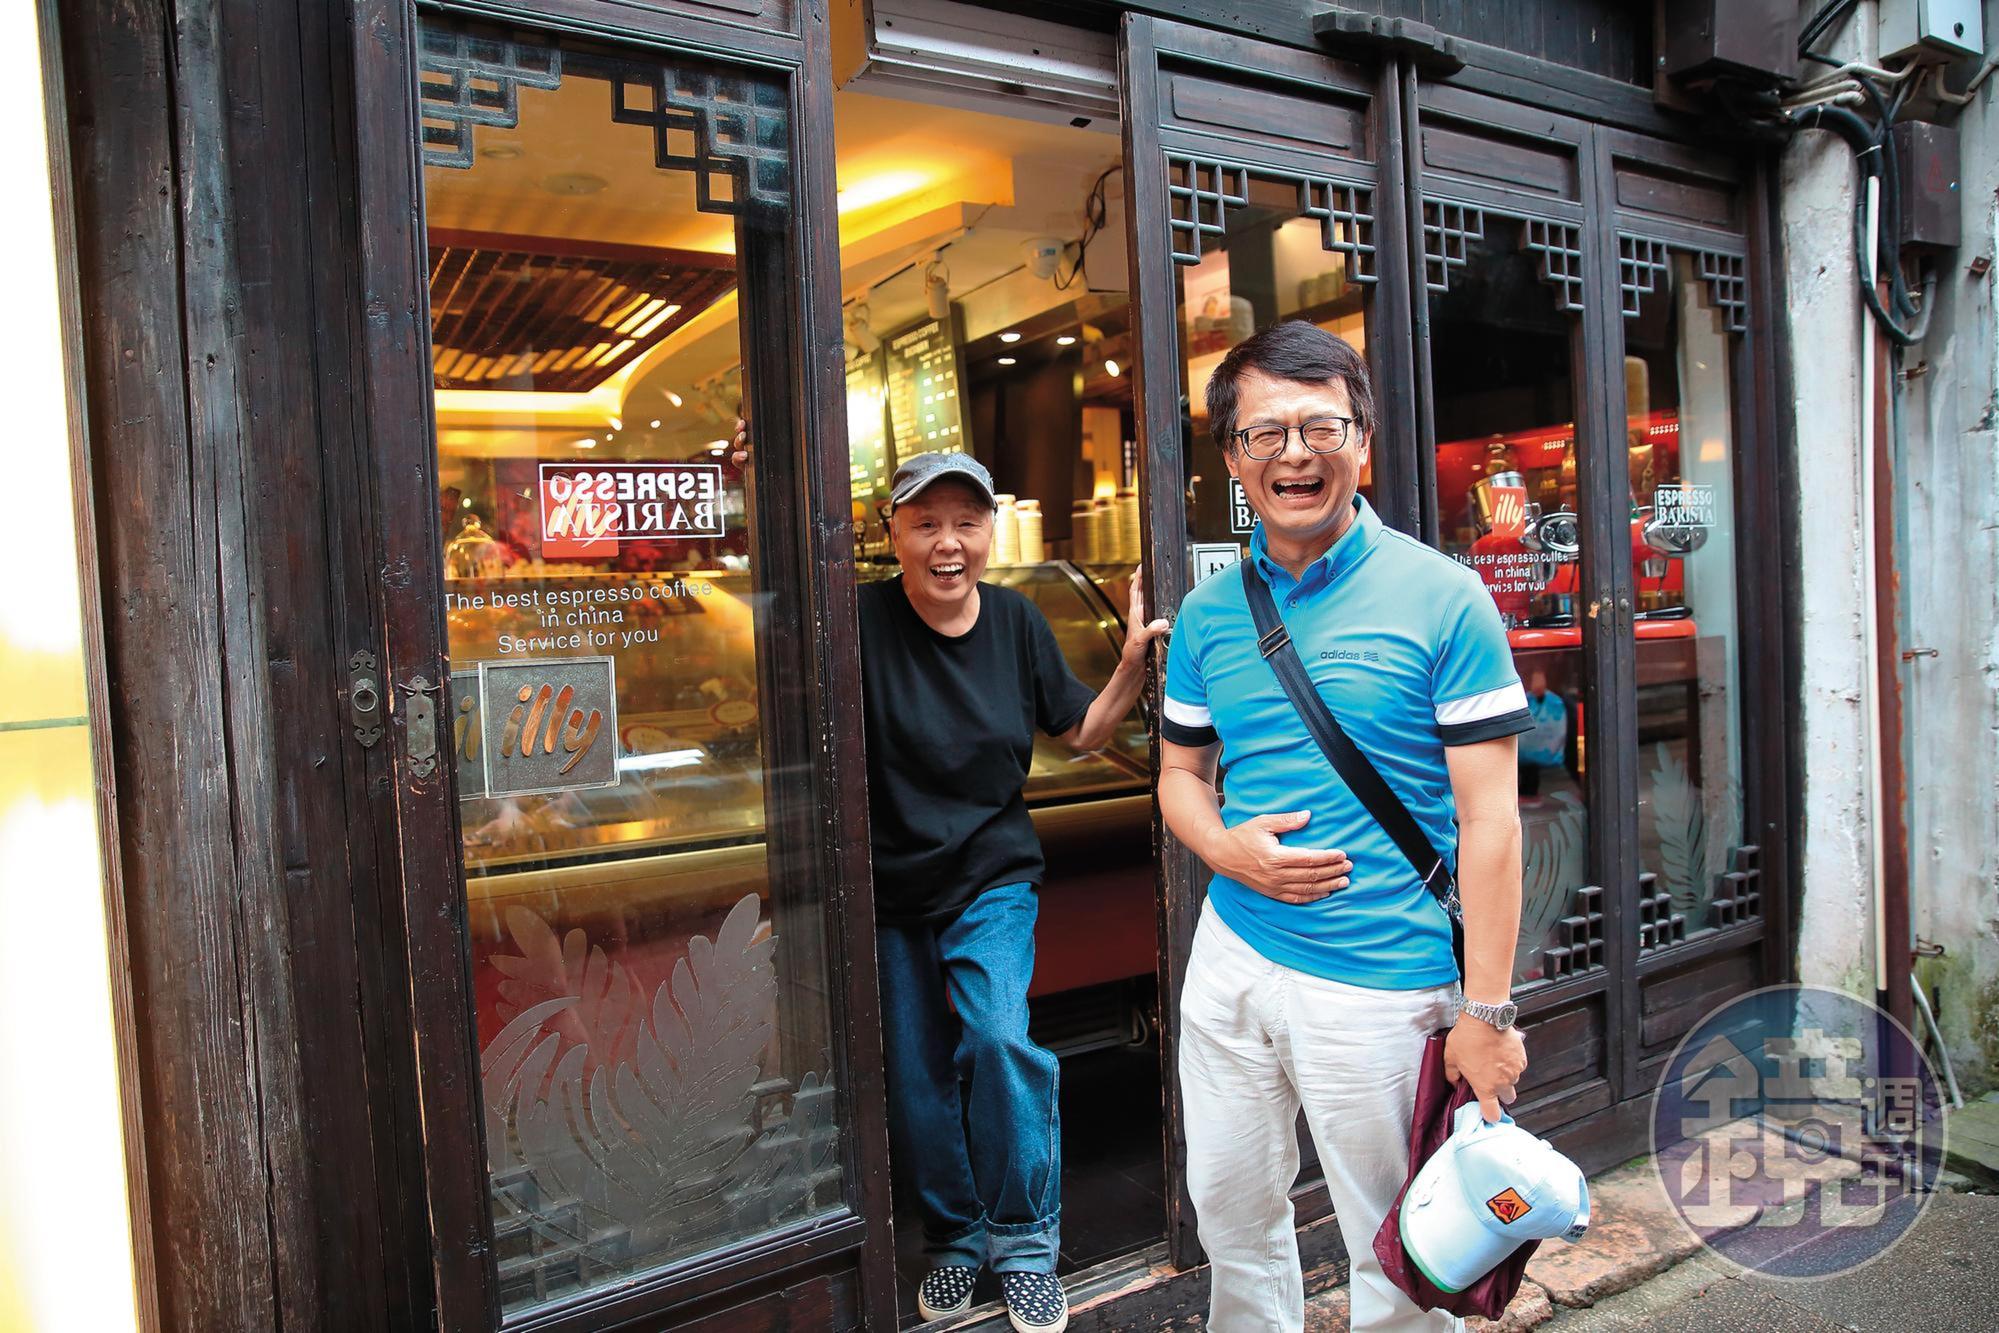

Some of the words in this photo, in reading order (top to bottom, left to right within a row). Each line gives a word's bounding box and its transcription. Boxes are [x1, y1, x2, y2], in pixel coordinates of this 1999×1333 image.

[1657, 489, 1712, 506] ESPRESSO
[1494, 494, 1523, 531] illy
[1658, 506, 1714, 524] BARISTA
[1494, 567, 1504, 579] in
[1505, 566, 1532, 579] china
[444, 593, 485, 612] The
[491, 589, 540, 609] best
[545, 584, 644, 609] espresso
[649, 580, 713, 601] coffee
[1485, 581, 1513, 593] ervice
[1514, 581, 1527, 592] for
[540, 609, 560, 628] in
[566, 605, 624, 627] china
[497, 632, 581, 654] Service
[586, 629, 616, 647] for
[621, 627, 659, 649] you
[1320, 650, 1361, 661] adidas
[501, 682, 604, 776] illy
